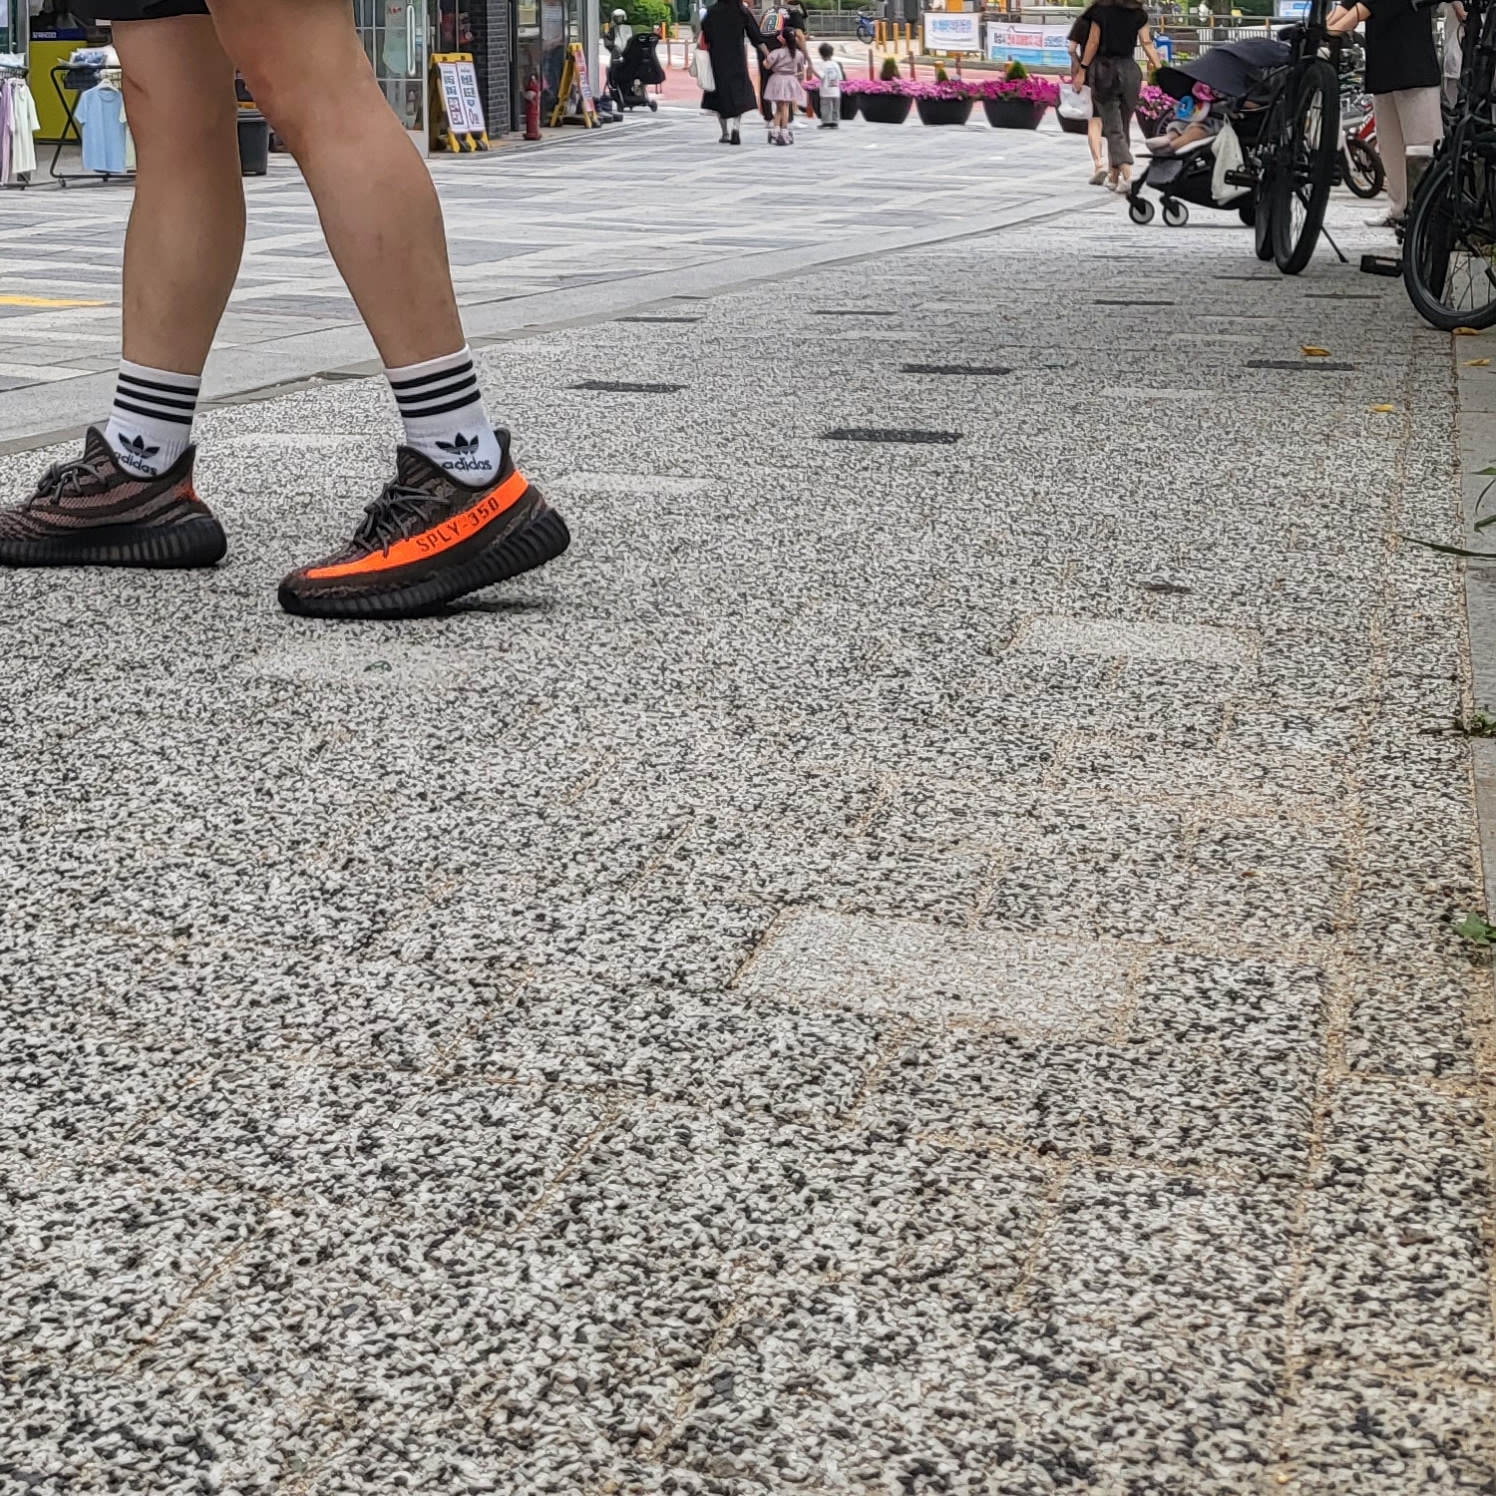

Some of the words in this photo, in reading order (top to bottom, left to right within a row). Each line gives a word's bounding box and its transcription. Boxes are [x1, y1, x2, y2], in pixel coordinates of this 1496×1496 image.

[114, 451, 158, 476] adidas
[442, 456, 492, 471] adidas
[415, 496, 500, 553] SPLY-350
